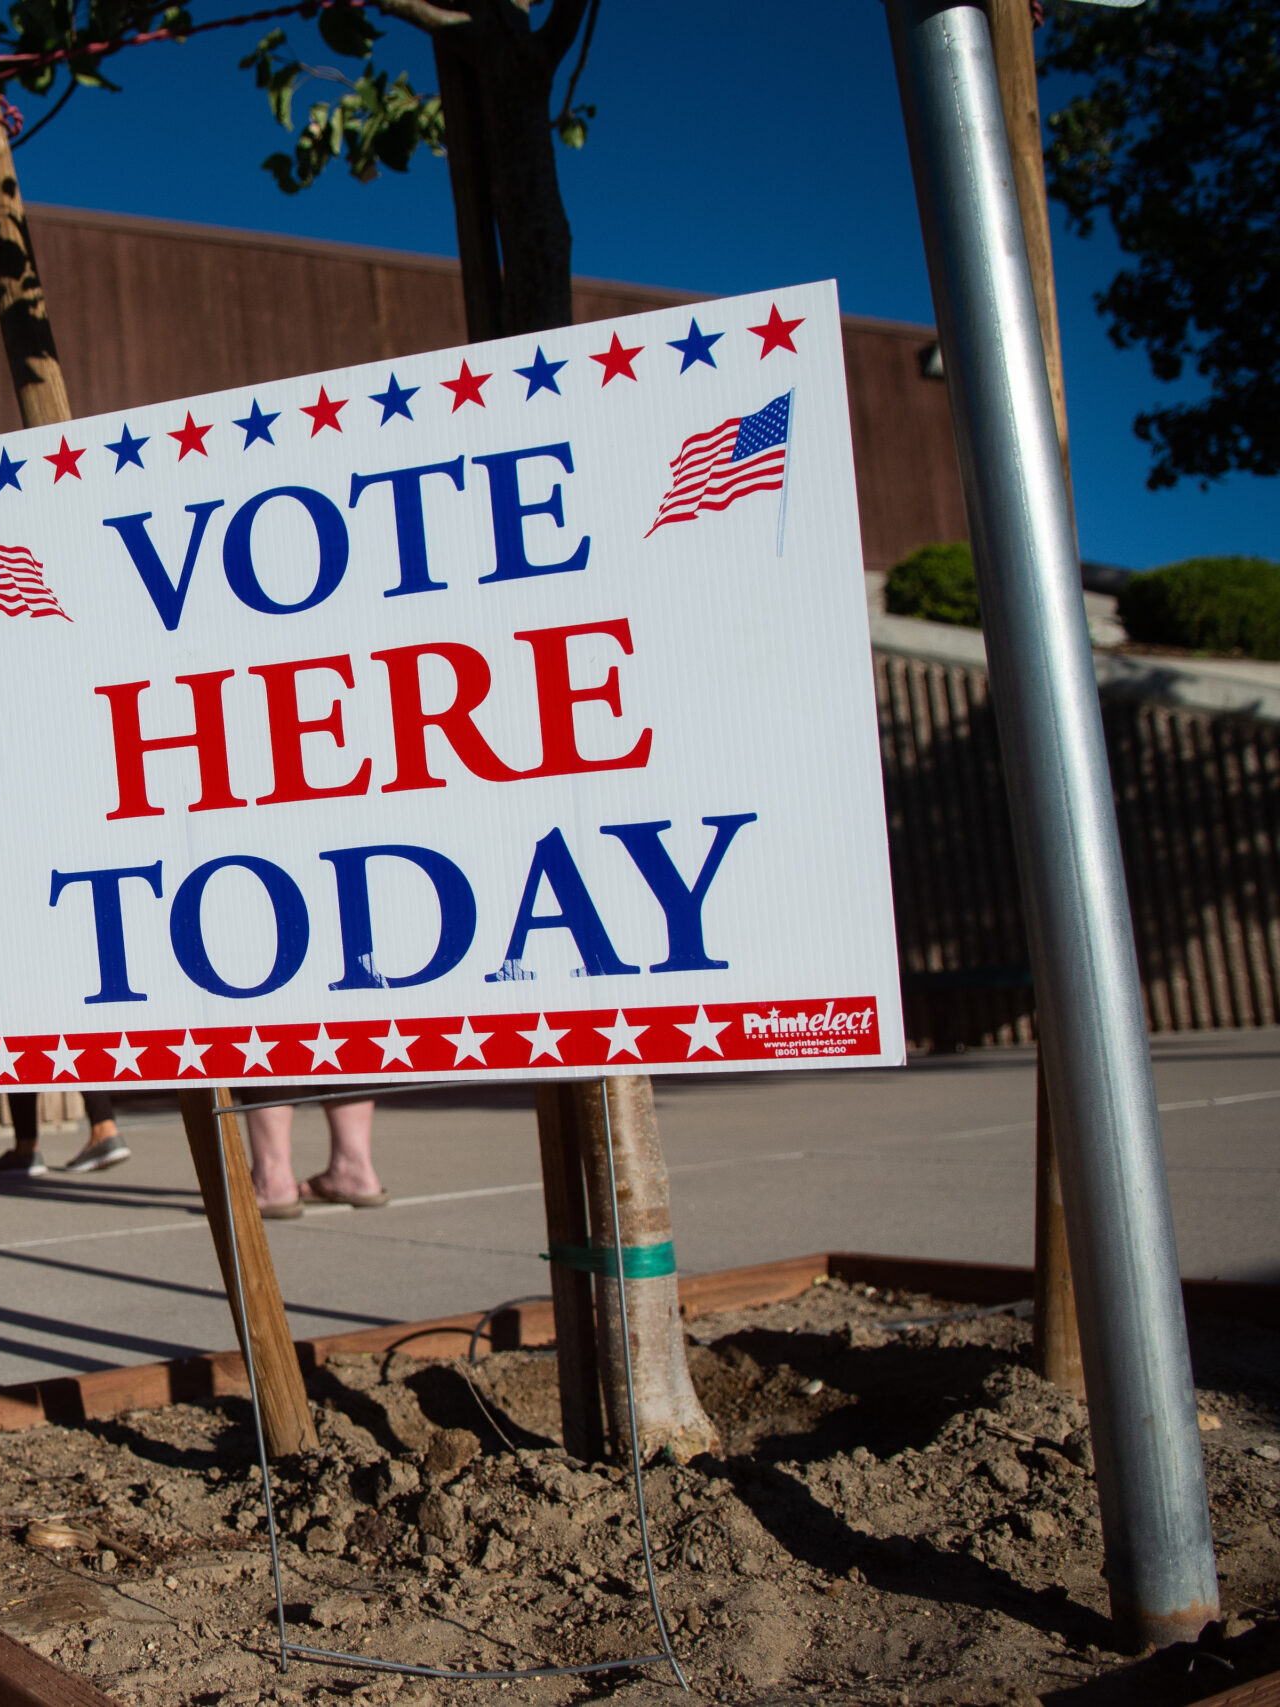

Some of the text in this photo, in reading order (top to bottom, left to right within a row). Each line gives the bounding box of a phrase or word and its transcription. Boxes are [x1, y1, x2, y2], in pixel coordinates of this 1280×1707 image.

[103, 441, 591, 631] VOTE
[94, 617, 653, 821] HERE
[49, 812, 758, 1005] TODAY
[742, 1001, 874, 1034] Printelect
[763, 1038, 857, 1048] www.printelect.com
[775, 1046, 847, 1057] (800) 682-4500
